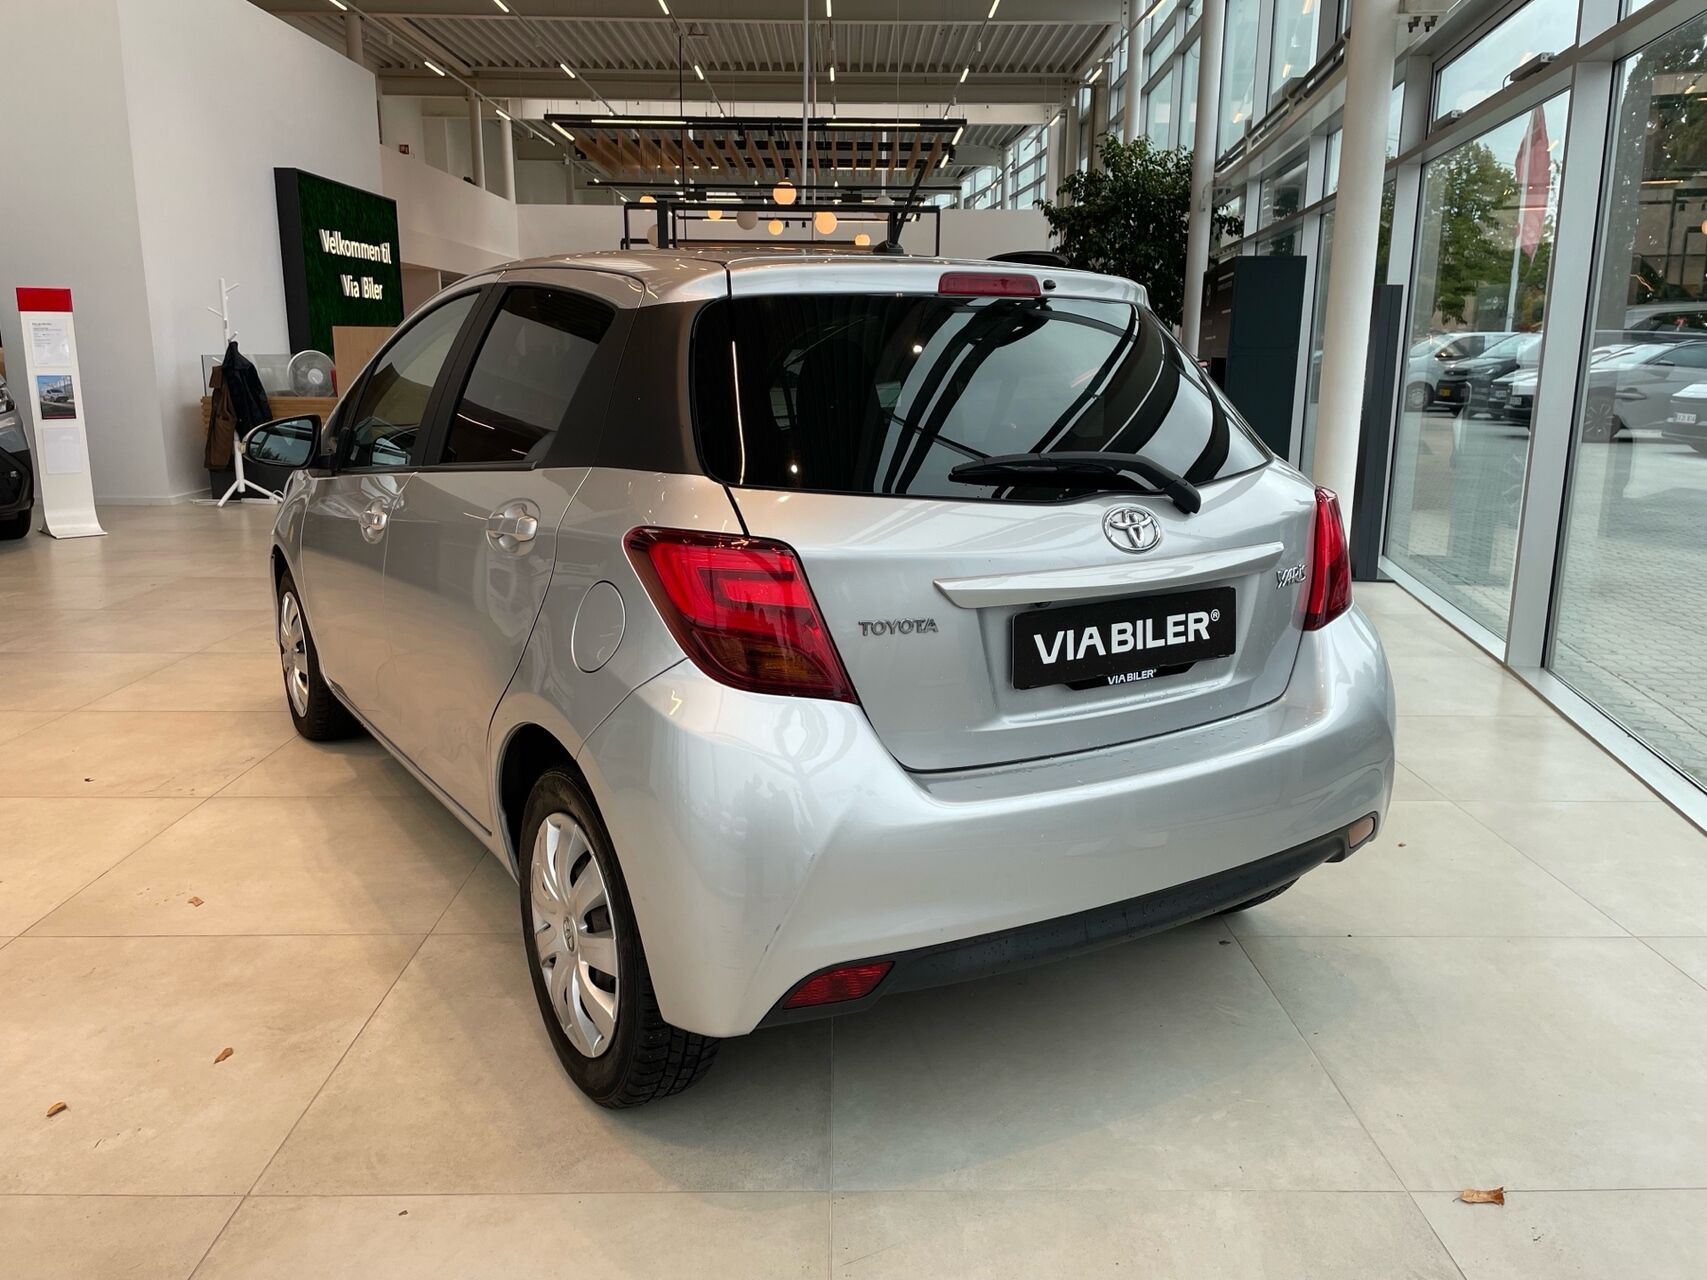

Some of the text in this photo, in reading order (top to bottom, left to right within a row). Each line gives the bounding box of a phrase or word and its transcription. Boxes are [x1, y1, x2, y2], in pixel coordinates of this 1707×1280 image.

[319, 229, 392, 264] Velkommen til
[340, 274, 383, 300] Via Biler
[858, 618, 939, 636] TOYOTA
[1033, 626, 1106, 665] VIA
[1107, 674, 1126, 685] VIA
